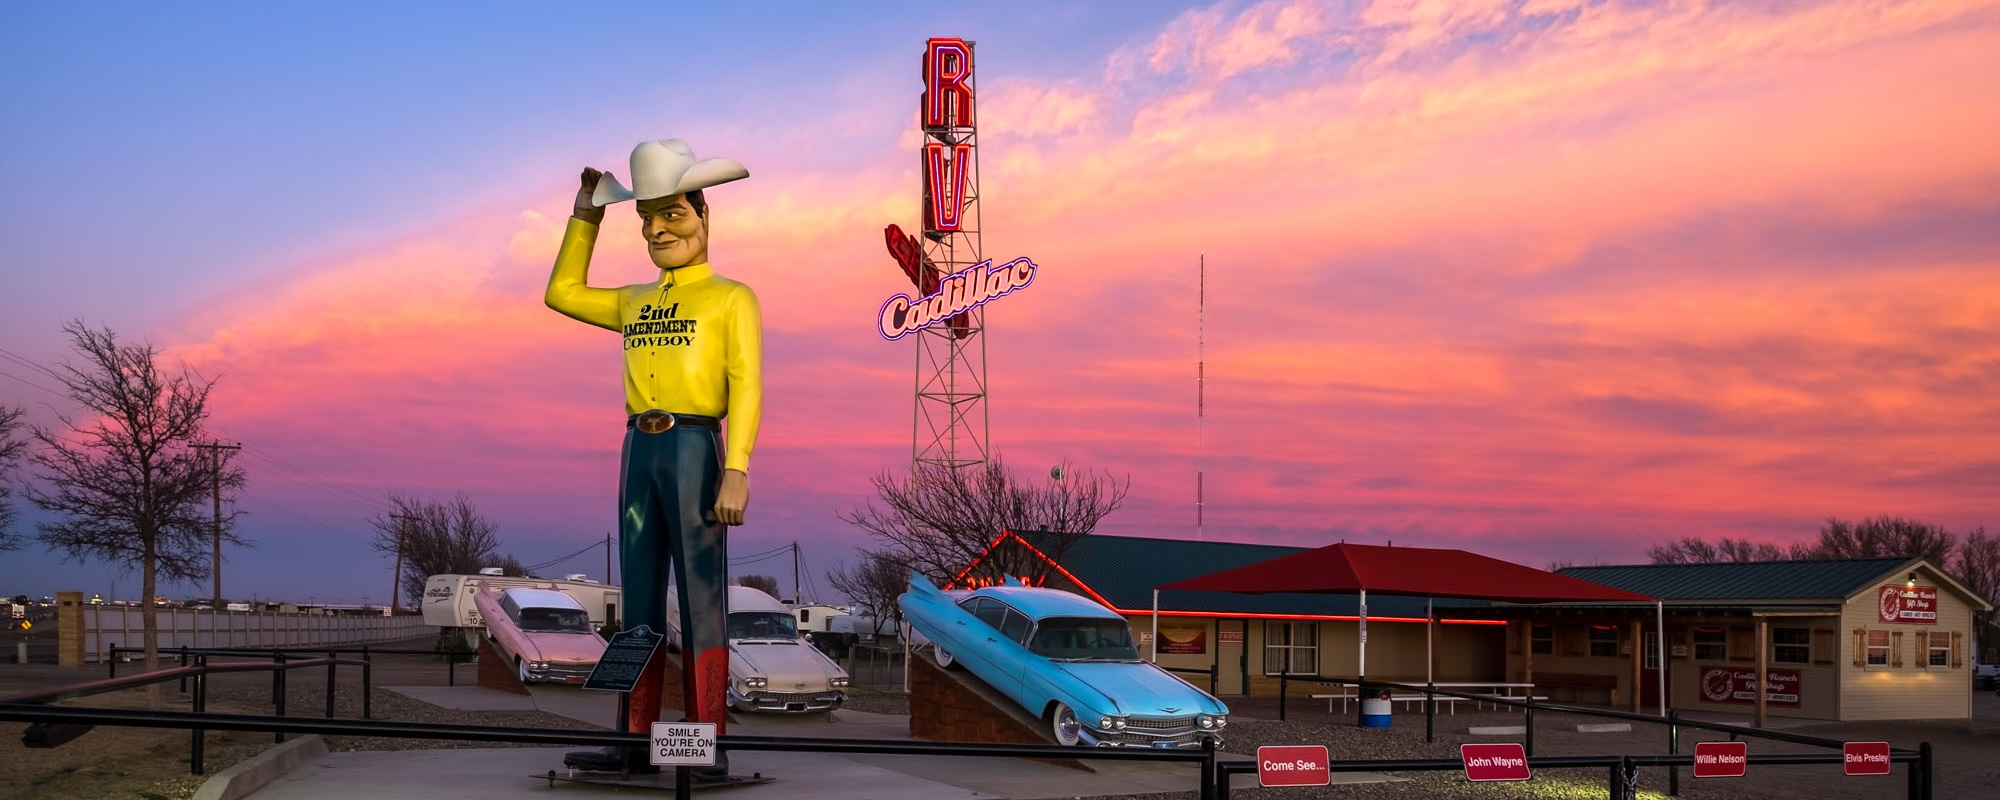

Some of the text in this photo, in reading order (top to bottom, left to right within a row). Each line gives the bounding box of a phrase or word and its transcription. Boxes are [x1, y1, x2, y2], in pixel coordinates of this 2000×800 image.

[926, 38, 972, 232] RV
[879, 257, 1037, 340] Cadillac
[638, 303, 679, 321] 2nd
[623, 319, 697, 338] AMENDMENT
[623, 335, 695, 350] COWBOY
[1768, 673, 1798, 682] Ranch
[668, 728, 701, 737] SMILE
[654, 737, 713, 748] YOU'RE ON
[660, 748, 706, 758] CAMERA
[1696, 753, 1744, 764] Willie Nelson
[1845, 753, 1889, 764] Elvis Presley
[1263, 759, 1326, 772] Come See...
[1468, 756, 1523, 769] John Wayne
